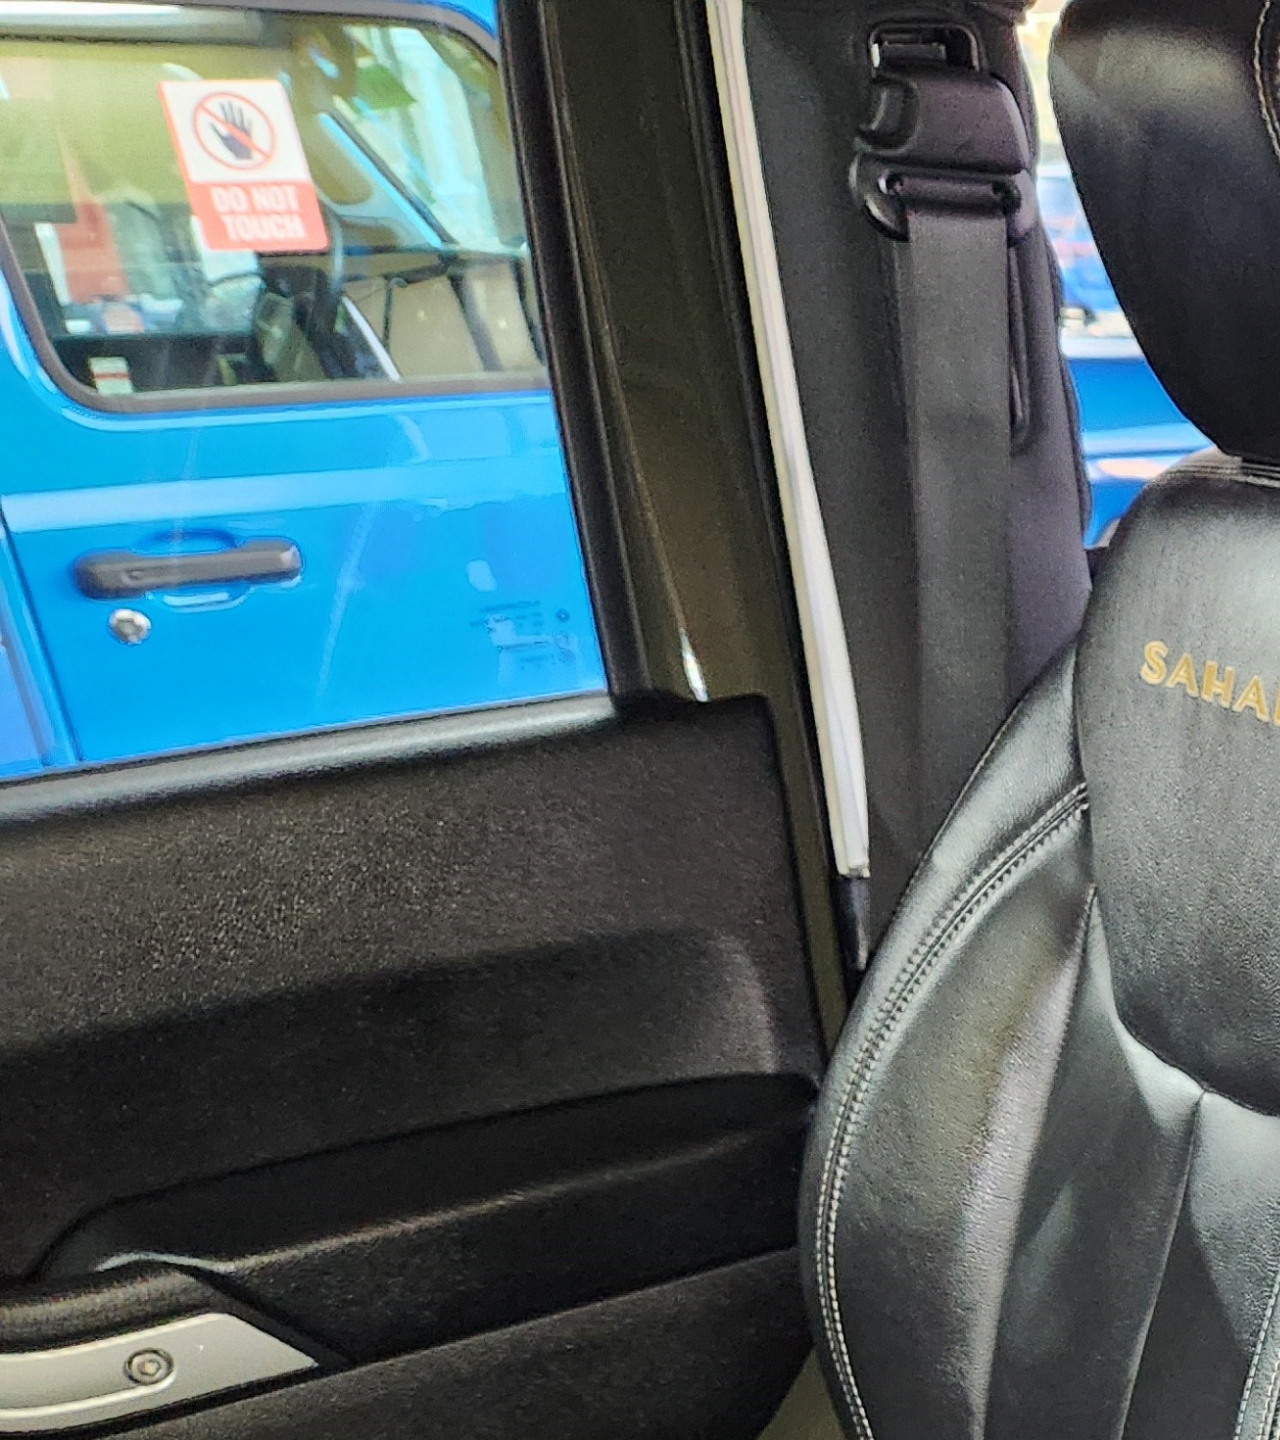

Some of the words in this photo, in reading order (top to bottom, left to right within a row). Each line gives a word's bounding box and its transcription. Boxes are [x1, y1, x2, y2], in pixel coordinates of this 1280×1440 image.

[210, 186, 248, 213] DO
[251, 185, 299, 212] NOT
[221, 213, 306, 242] TOUCH
